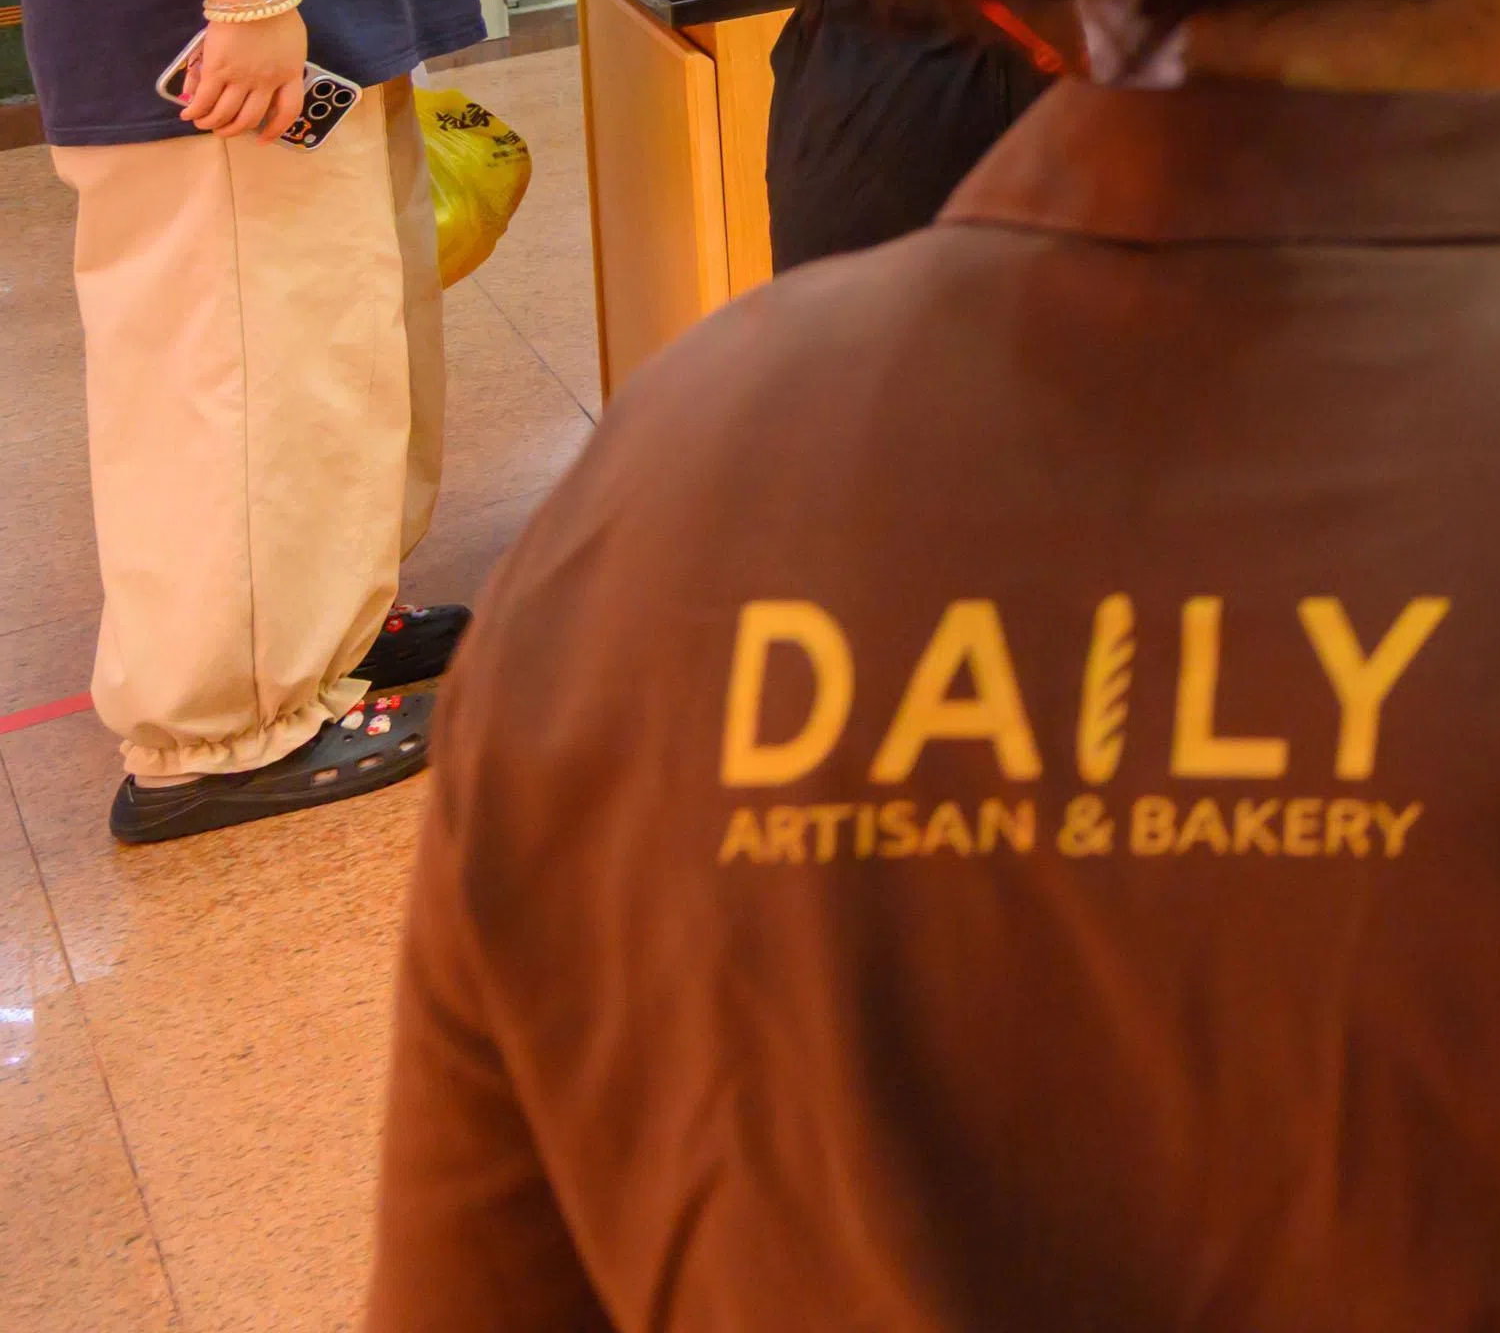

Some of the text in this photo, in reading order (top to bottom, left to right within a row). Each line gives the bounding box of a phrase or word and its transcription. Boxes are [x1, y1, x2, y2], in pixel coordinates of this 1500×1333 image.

[720, 592, 1452, 789] DAILY
[718, 794, 1424, 866] ARTISAN & BAKERY
